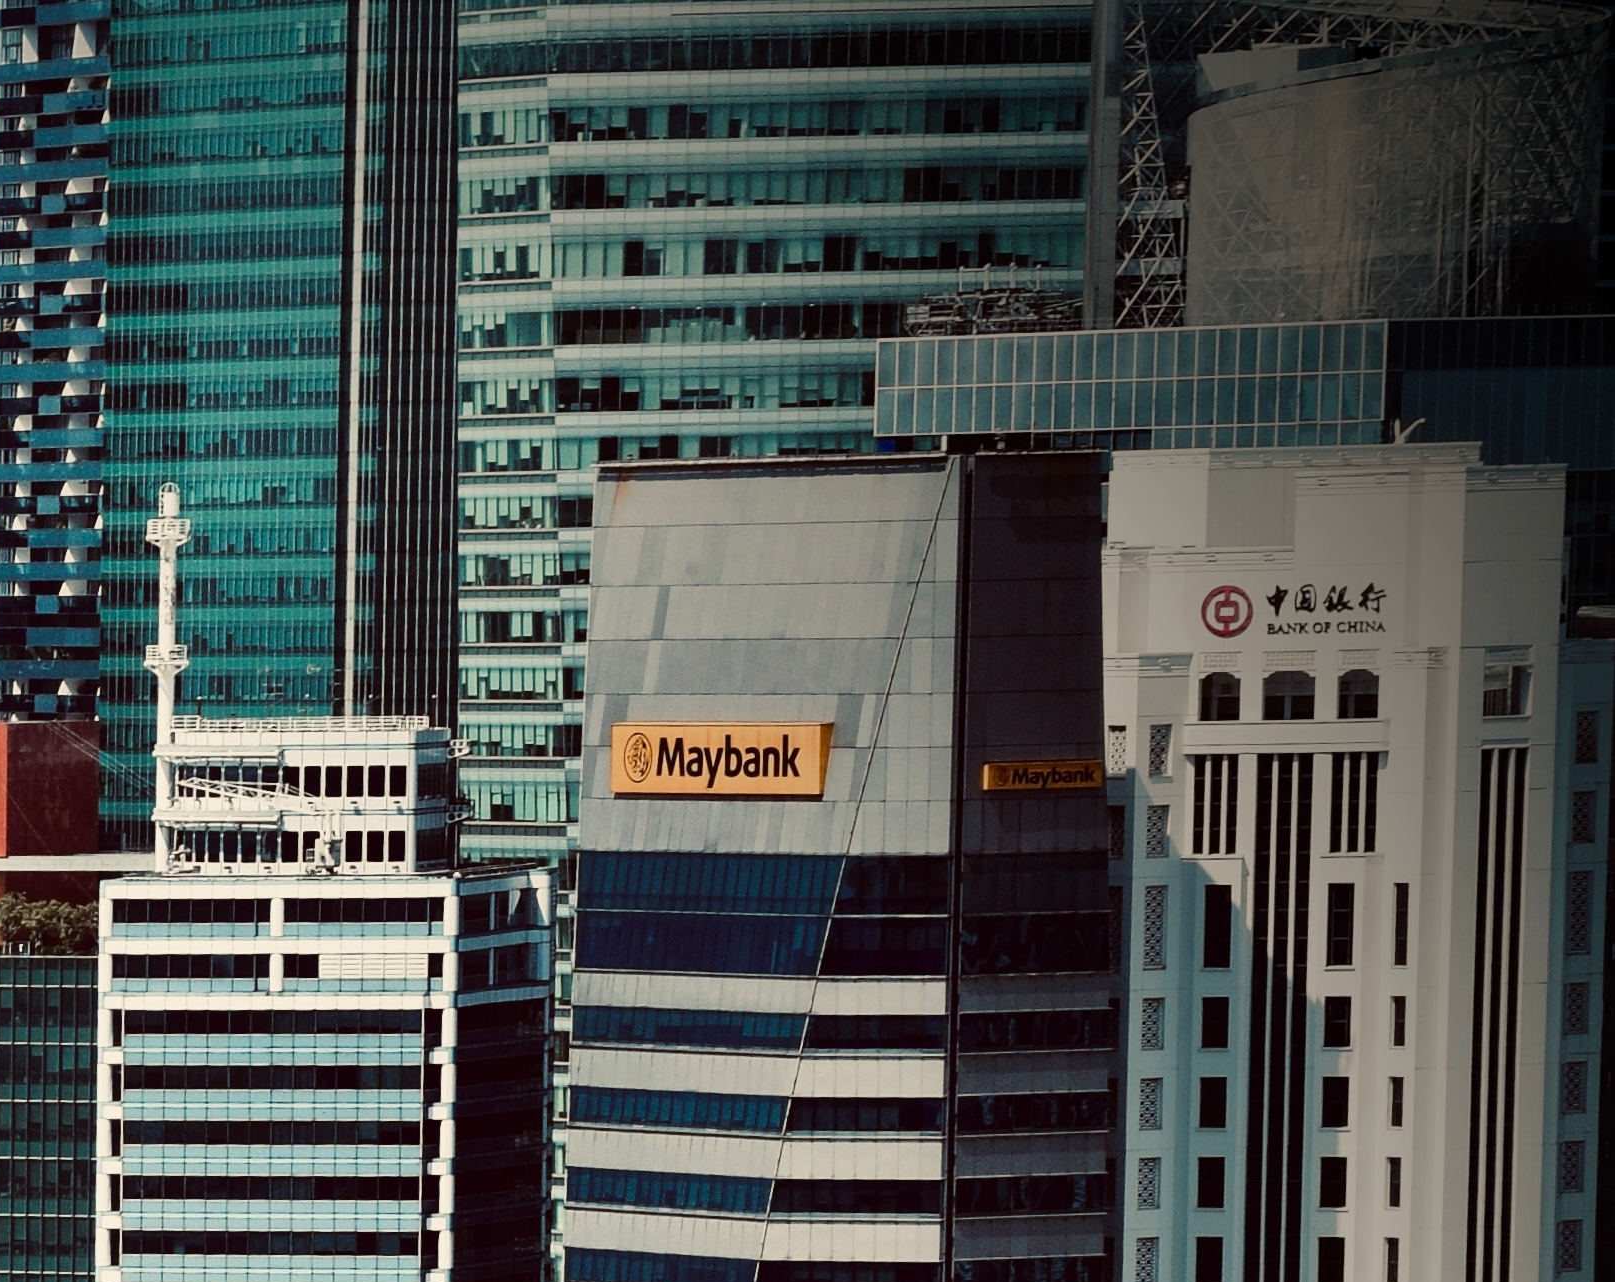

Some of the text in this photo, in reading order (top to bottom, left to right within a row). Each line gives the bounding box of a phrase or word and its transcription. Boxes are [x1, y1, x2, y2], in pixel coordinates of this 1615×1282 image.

[1267, 621, 1387, 635] BANK OF CHINA
[655, 734, 801, 789] Maybank
[1011, 766, 1096, 788] Maybank
